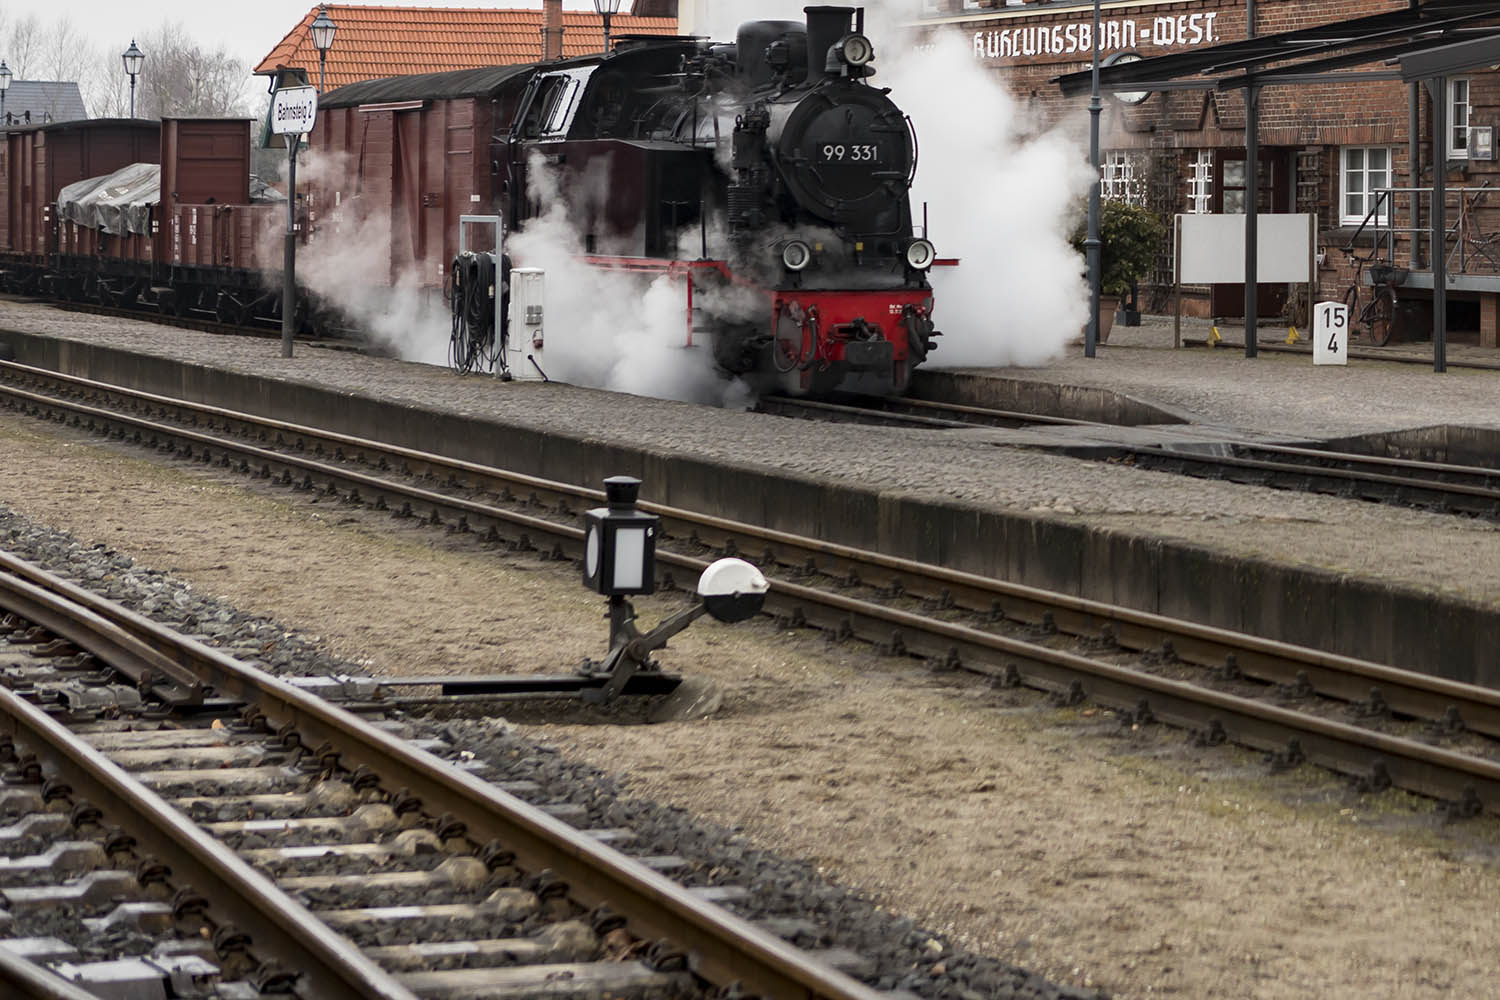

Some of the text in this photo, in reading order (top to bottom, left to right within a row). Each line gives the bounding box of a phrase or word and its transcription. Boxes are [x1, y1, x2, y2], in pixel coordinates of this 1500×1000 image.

[278, 100, 313, 124] Bahnsteig 2
[823, 145, 878, 161] 99 331
[1323, 307, 1345, 328] 15
[1327, 332, 1339, 353] 4
